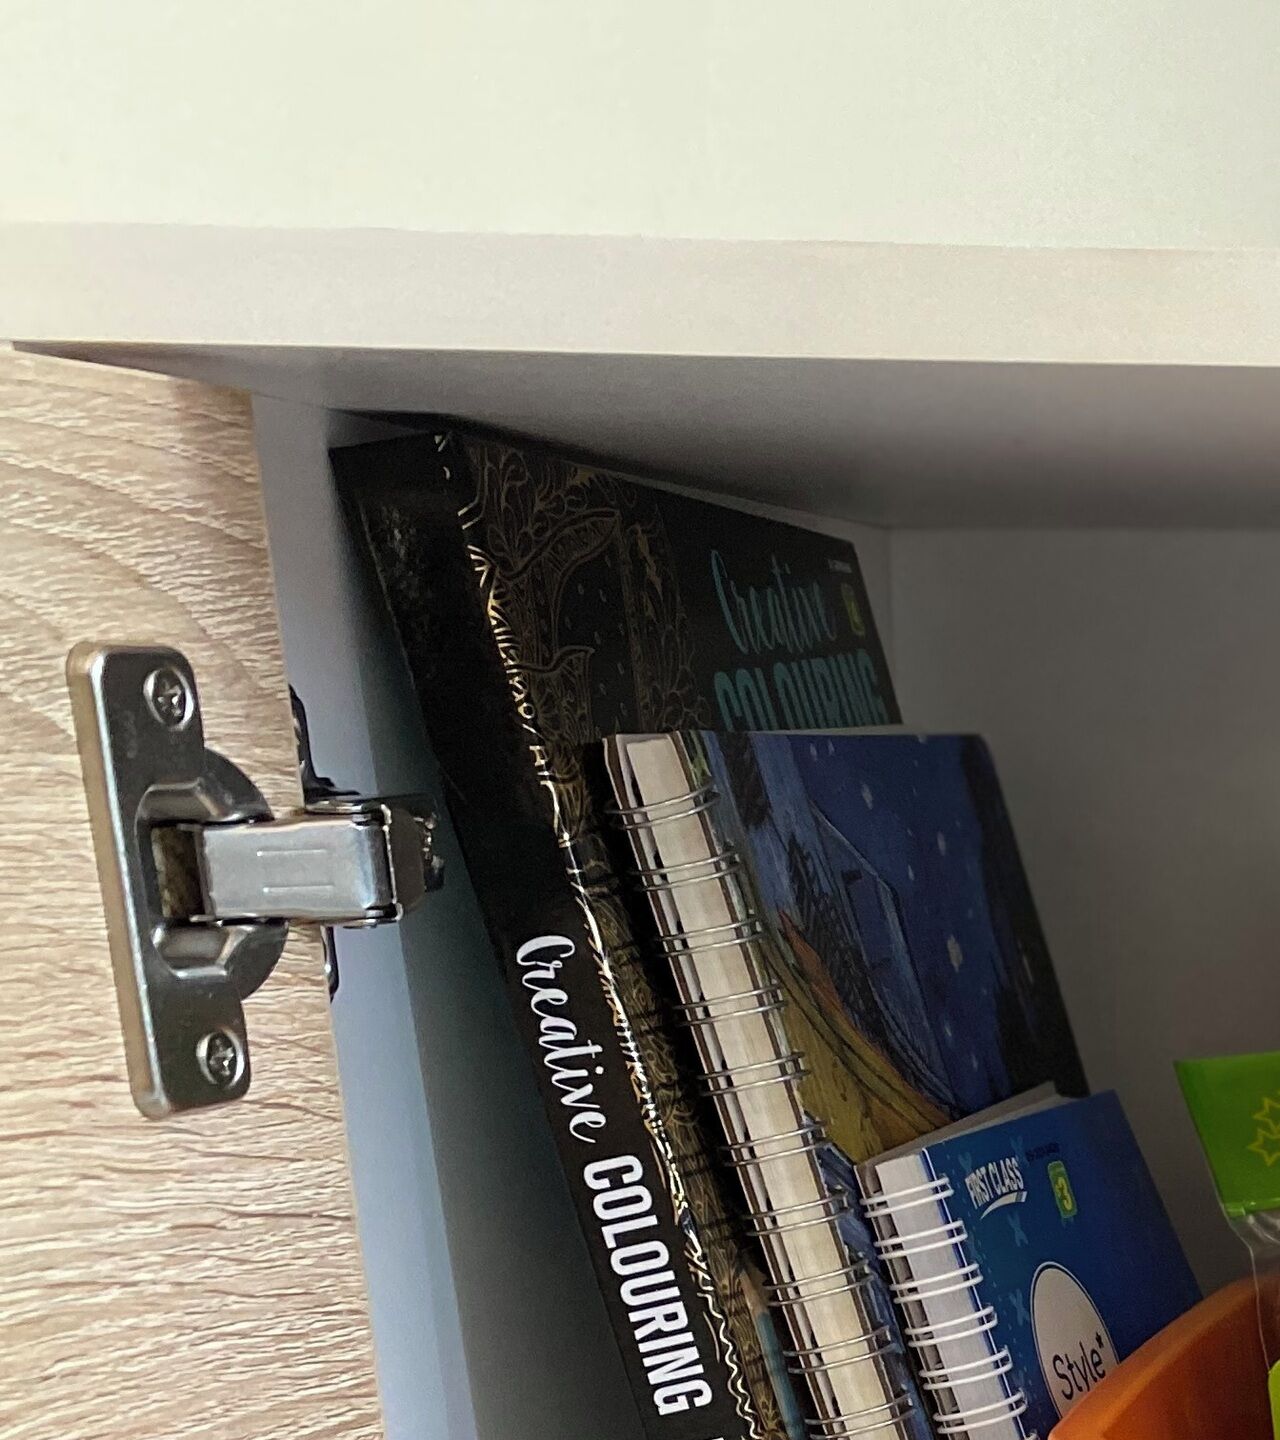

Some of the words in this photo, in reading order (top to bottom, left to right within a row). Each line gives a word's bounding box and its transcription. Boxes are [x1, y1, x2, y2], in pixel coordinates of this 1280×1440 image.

[711, 550, 837, 655] Creative
[514, 934, 608, 1144] Creative
[583, 1155, 713, 1416] COLOURING
[964, 1167, 994, 1210] FIRST
[988, 1156, 1024, 1196] CLASS
